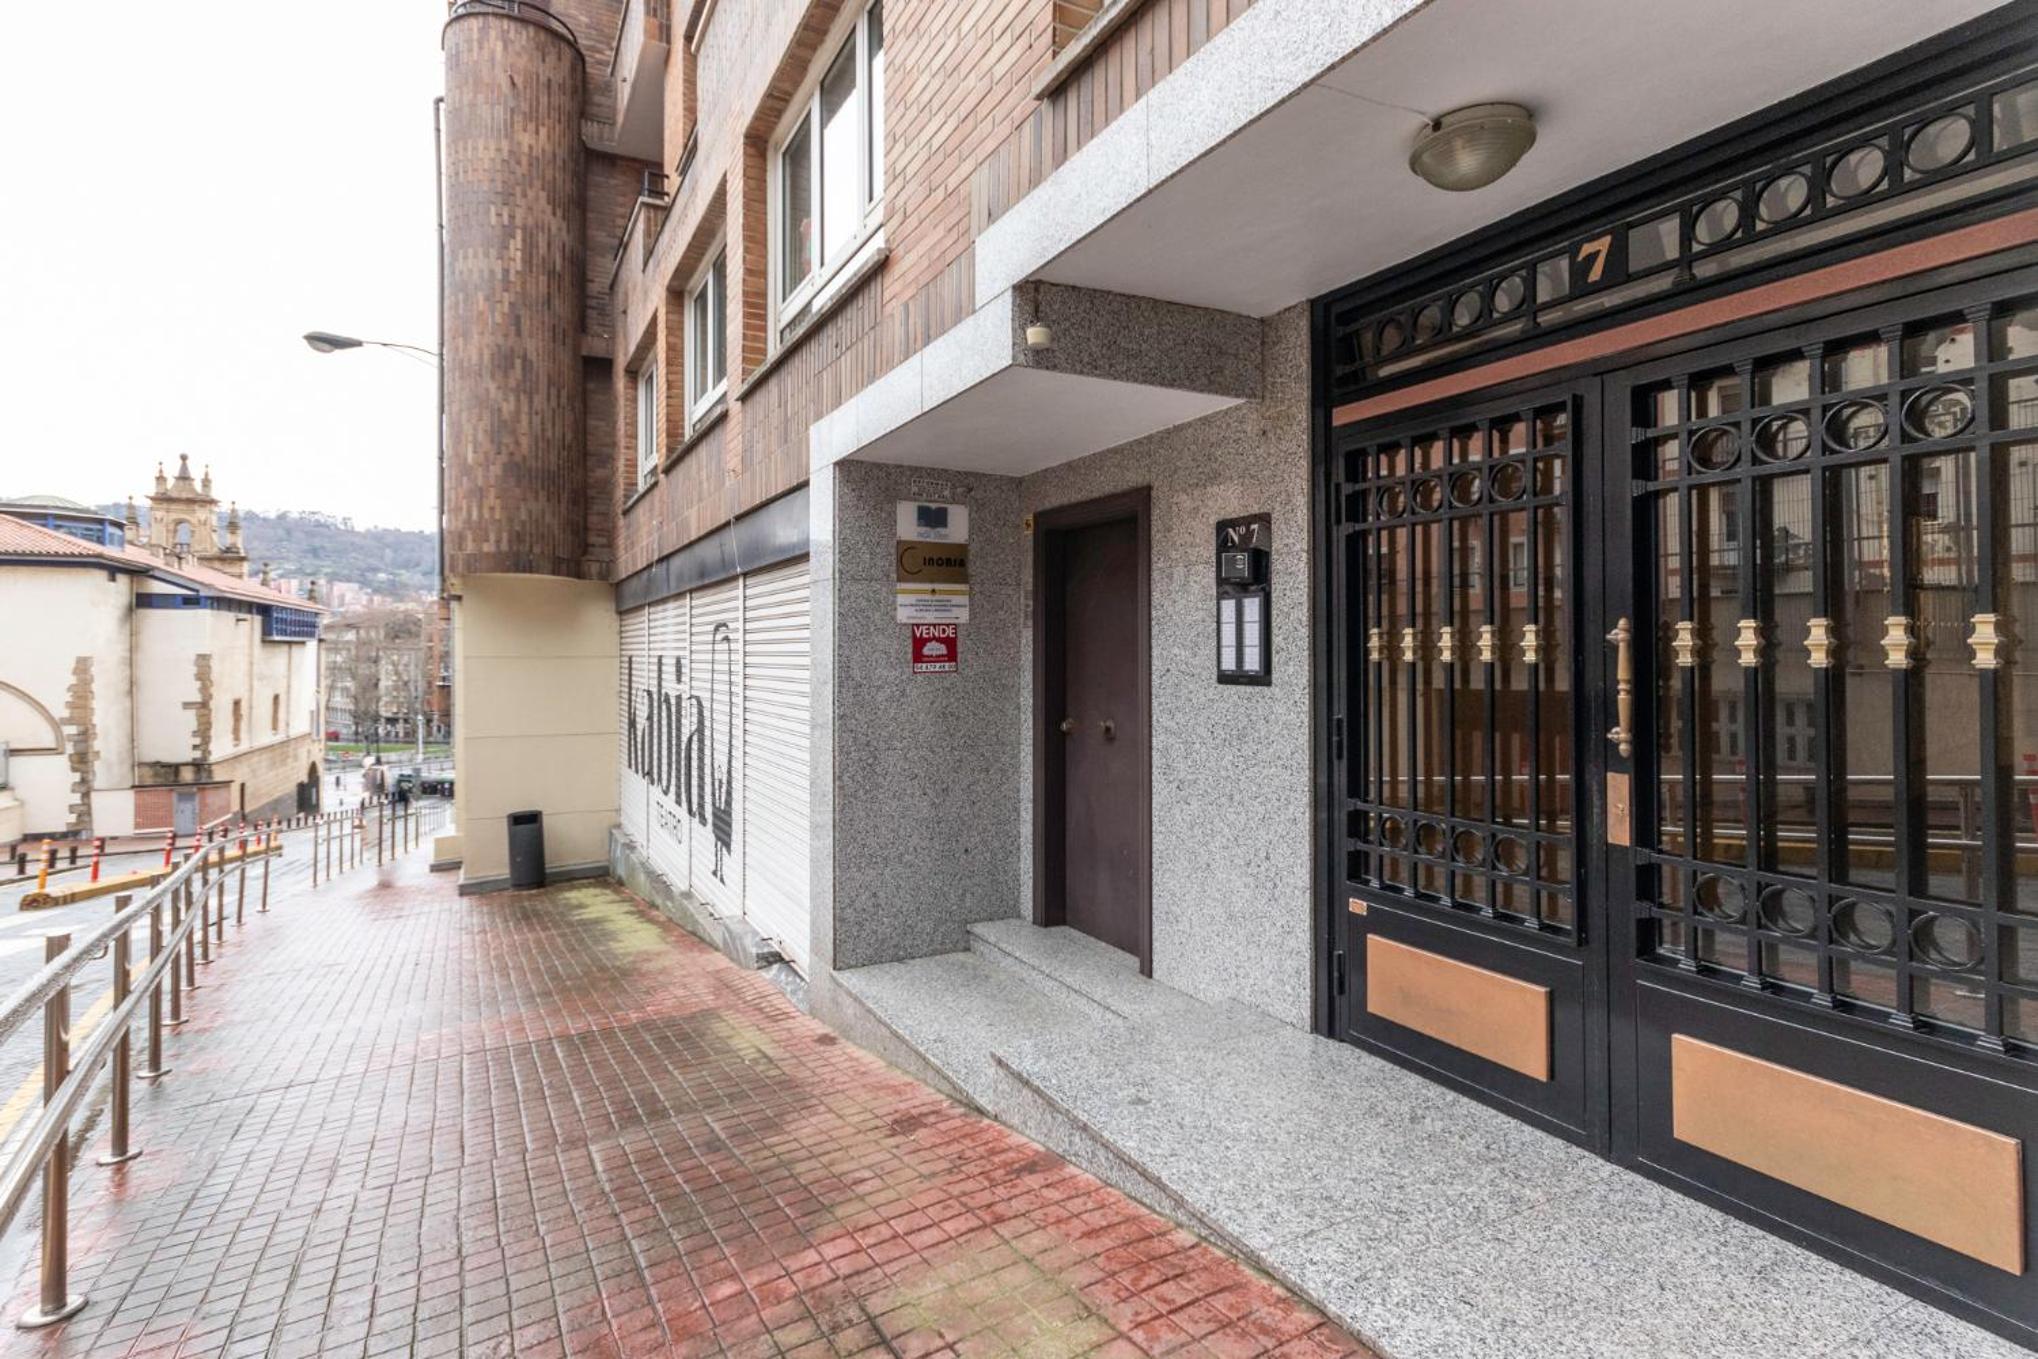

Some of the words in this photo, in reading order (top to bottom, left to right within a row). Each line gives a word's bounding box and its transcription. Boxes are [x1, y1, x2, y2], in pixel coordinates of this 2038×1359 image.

[1577, 234, 1612, 283] 7
[1227, 525, 1246, 546] Nº
[1250, 523, 1259, 544] 7
[913, 625, 956, 638] VENDE
[628, 655, 707, 827] kabia
